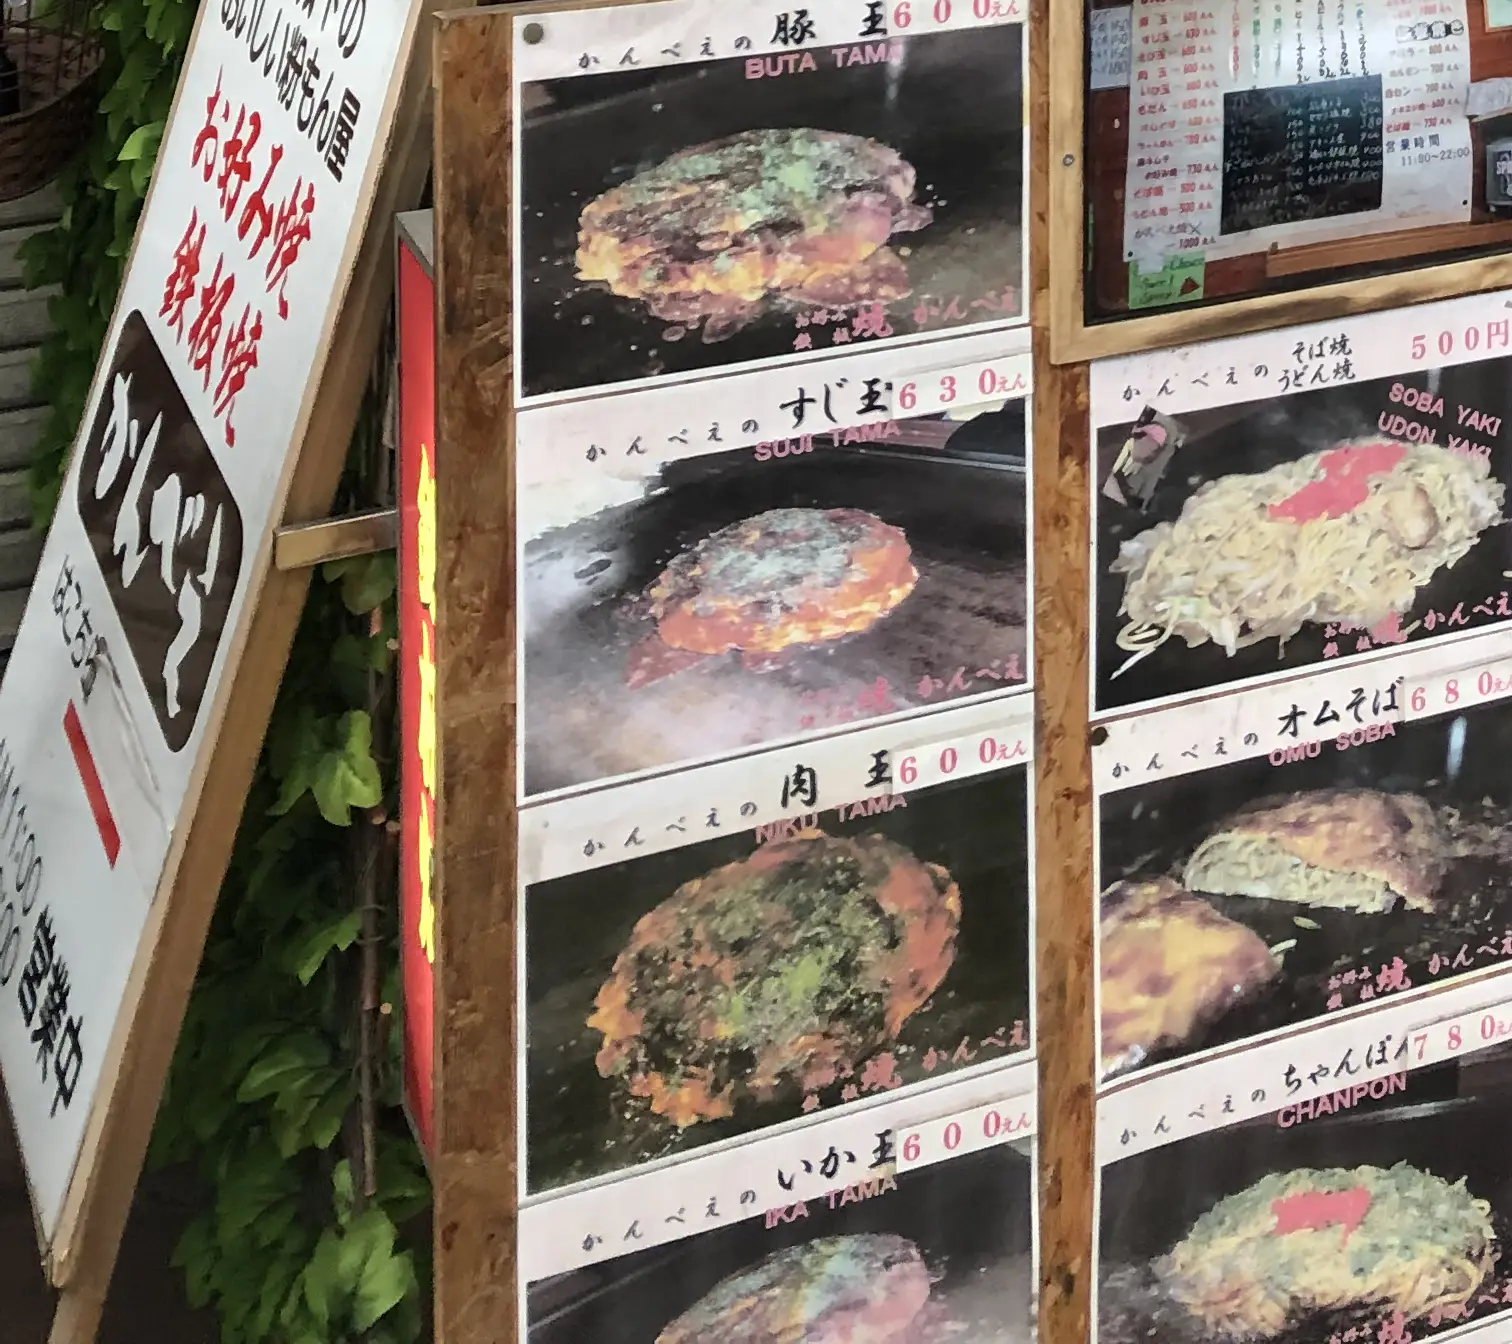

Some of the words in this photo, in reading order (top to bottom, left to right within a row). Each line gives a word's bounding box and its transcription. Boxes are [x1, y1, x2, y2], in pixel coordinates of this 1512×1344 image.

[578, 34, 752, 70] かんべえの
[745, 53, 818, 80] BUTA
[831, 44, 902, 68] TAMA
[1385, 133, 1440, 154] 営業時間
[190, 65, 316, 321] お好み焼
[159, 206, 263, 448] 鉄板焼
[1291, 332, 1354, 360] そば焼
[1411, 319, 1511, 361] 500円
[1121, 363, 1270, 403] かんべえの
[1277, 362, 1356, 394] うどん焼
[1388, 382, 1445, 418] SOBA
[1456, 404, 1502, 438] YAKI
[585, 416, 760, 464] かんべえの
[779, 377, 893, 430] すじ玉
[754, 438, 815, 462] SUJI
[828, 419, 901, 446] TAMA
[1378, 411, 1437, 446] UDON
[95, 371, 225, 719] かんべえ
[1423, 591, 1512, 631] かんべえ
[1111, 732, 1259, 779] かんべえの
[1277, 676, 1406, 739] オムそば
[1269, 740, 1322, 768] OMU
[1336, 720, 1396, 752] SOBA
[582, 800, 759, 859] かんべえの
[754, 815, 819, 845] NIKU
[834, 793, 907, 824] TAMA
[18, 903, 84, 1119] 営業中
[1119, 1088, 1267, 1146] かんべえの
[1276, 1072, 1408, 1130] CHANPON
[580, 1188, 757, 1252] かんべえの
[764, 1206, 809, 1229] IKA
[825, 1175, 898, 1209] TAMA
